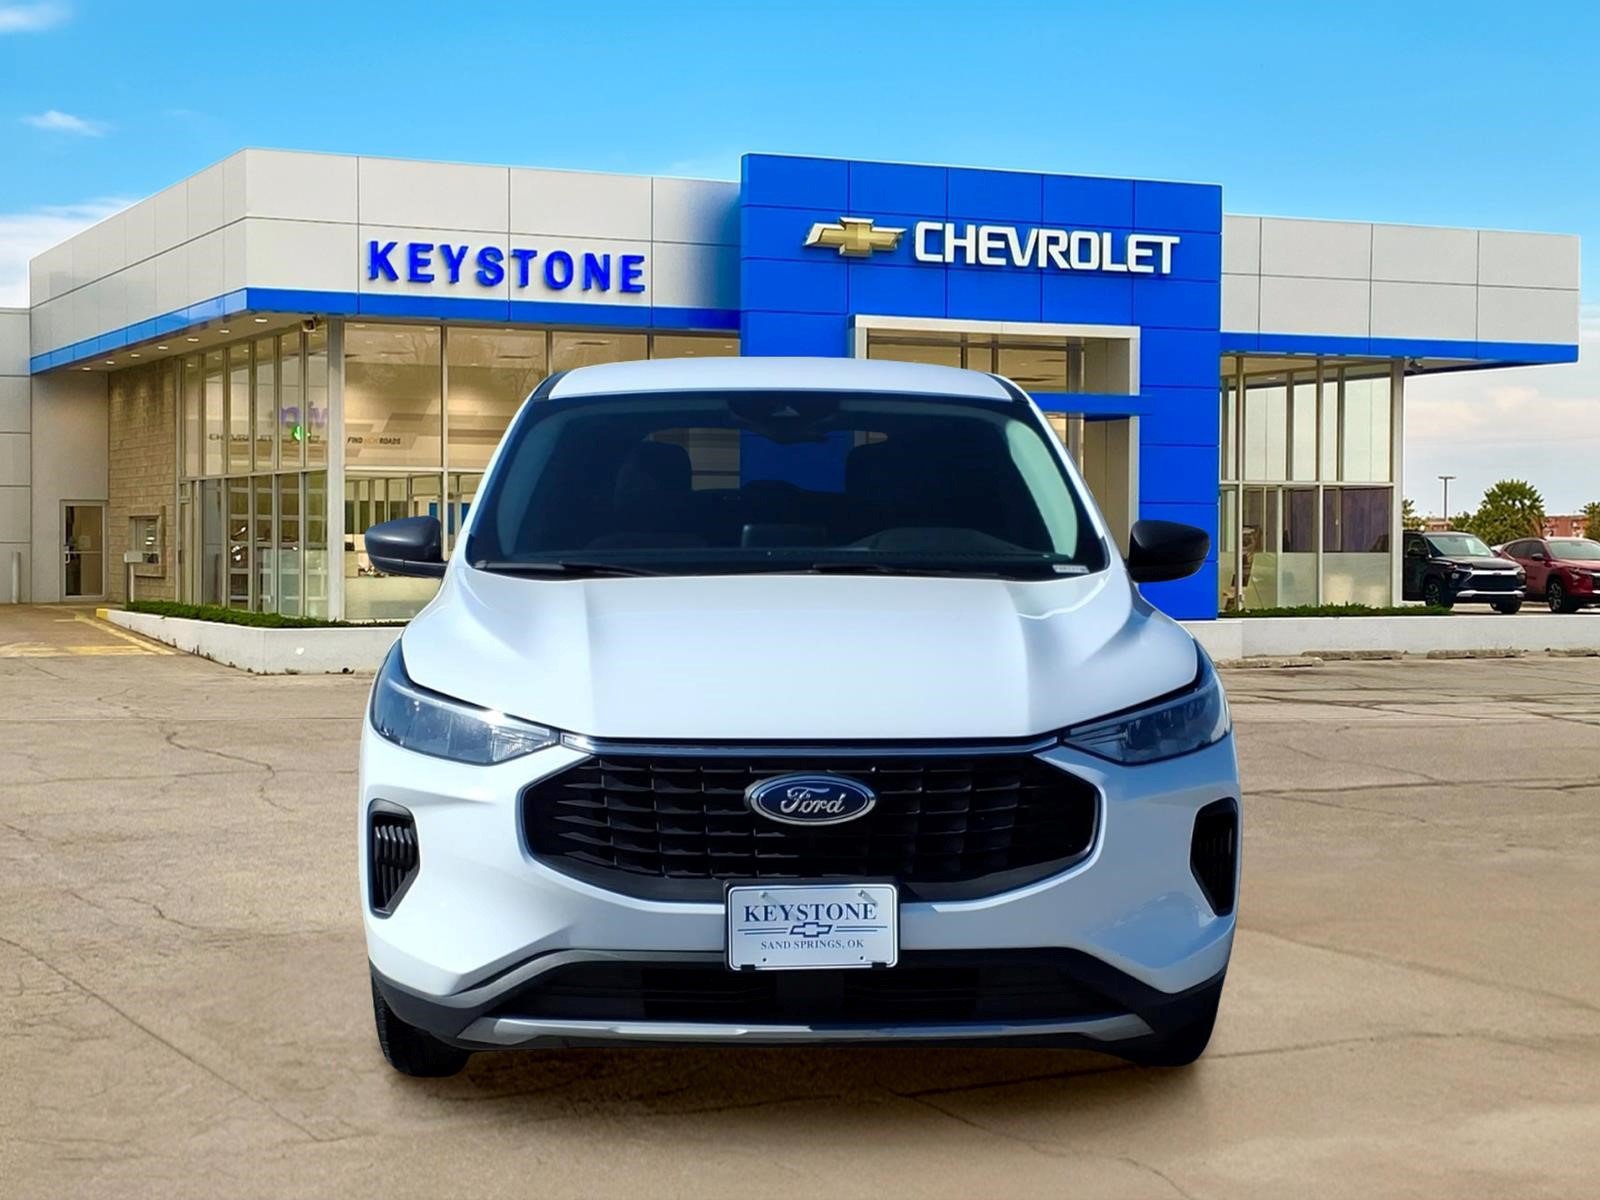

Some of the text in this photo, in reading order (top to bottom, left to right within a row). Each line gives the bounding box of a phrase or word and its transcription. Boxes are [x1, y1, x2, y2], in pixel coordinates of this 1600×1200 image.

[914, 221, 1180, 274] CHEVROLET
[368, 240, 646, 293] KEYSTONE
[780, 787, 846, 813] Ford
[744, 902, 878, 922] KEYSTONE
[760, 938, 864, 950] SAND SPRINGS, OK
